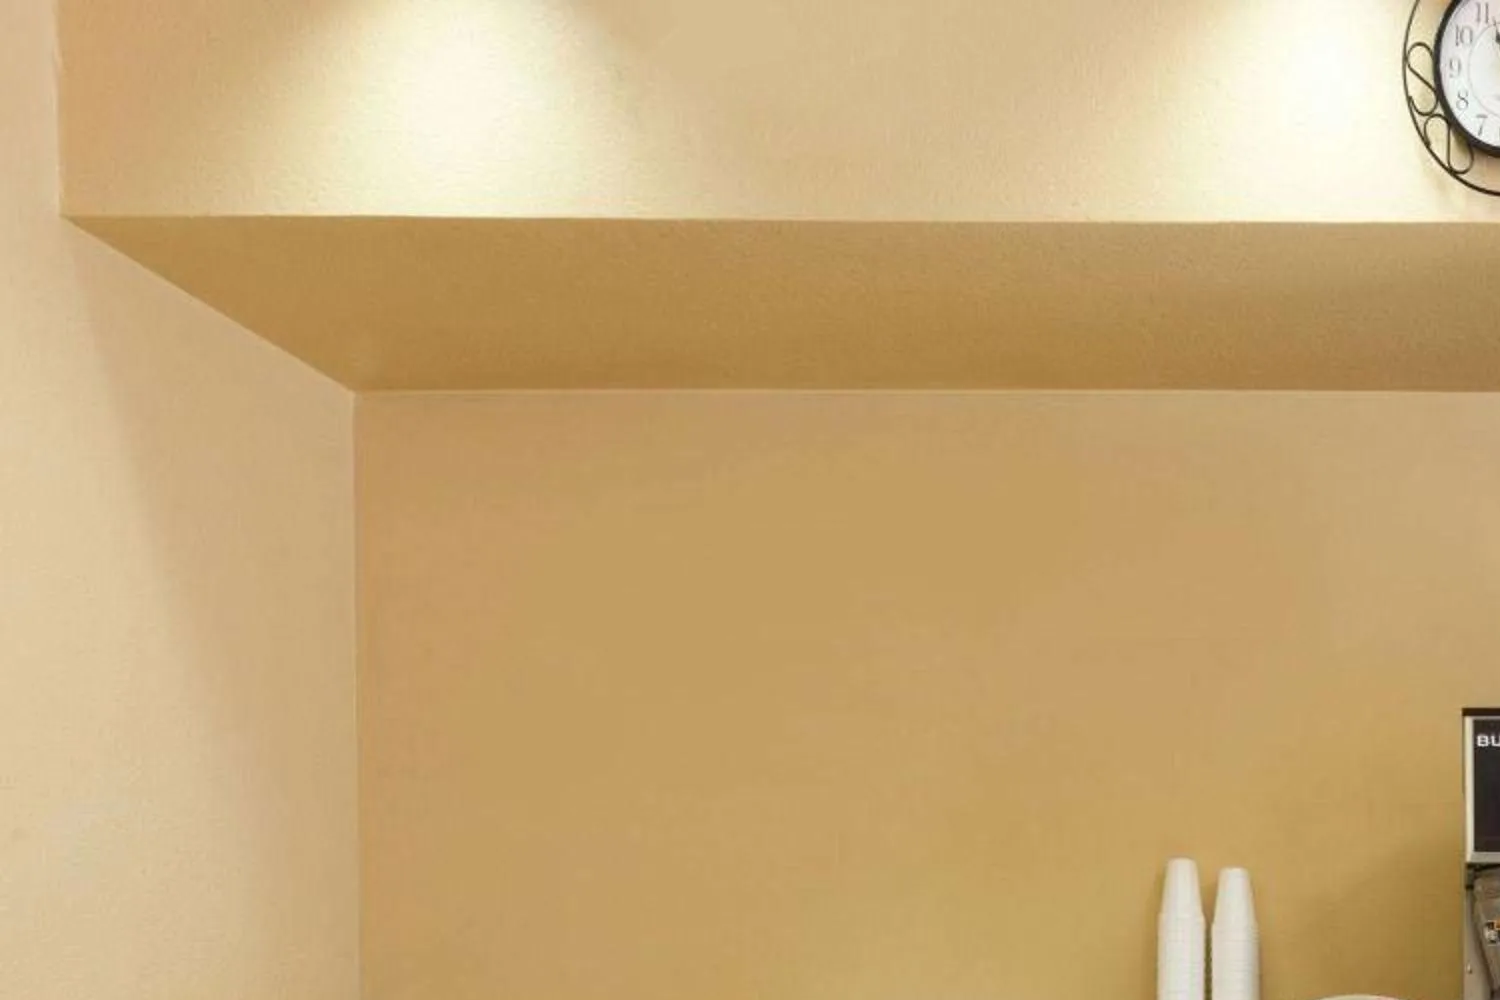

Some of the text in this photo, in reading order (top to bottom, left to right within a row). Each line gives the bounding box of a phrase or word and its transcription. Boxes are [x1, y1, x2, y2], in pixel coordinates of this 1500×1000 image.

[1476, 2, 1490, 24] 11
[1455, 25, 1473, 47] 10
[1449, 58, 1462, 79] 9
[1456, 91, 1469, 111] 8
[1476, 113, 1488, 137] 7
